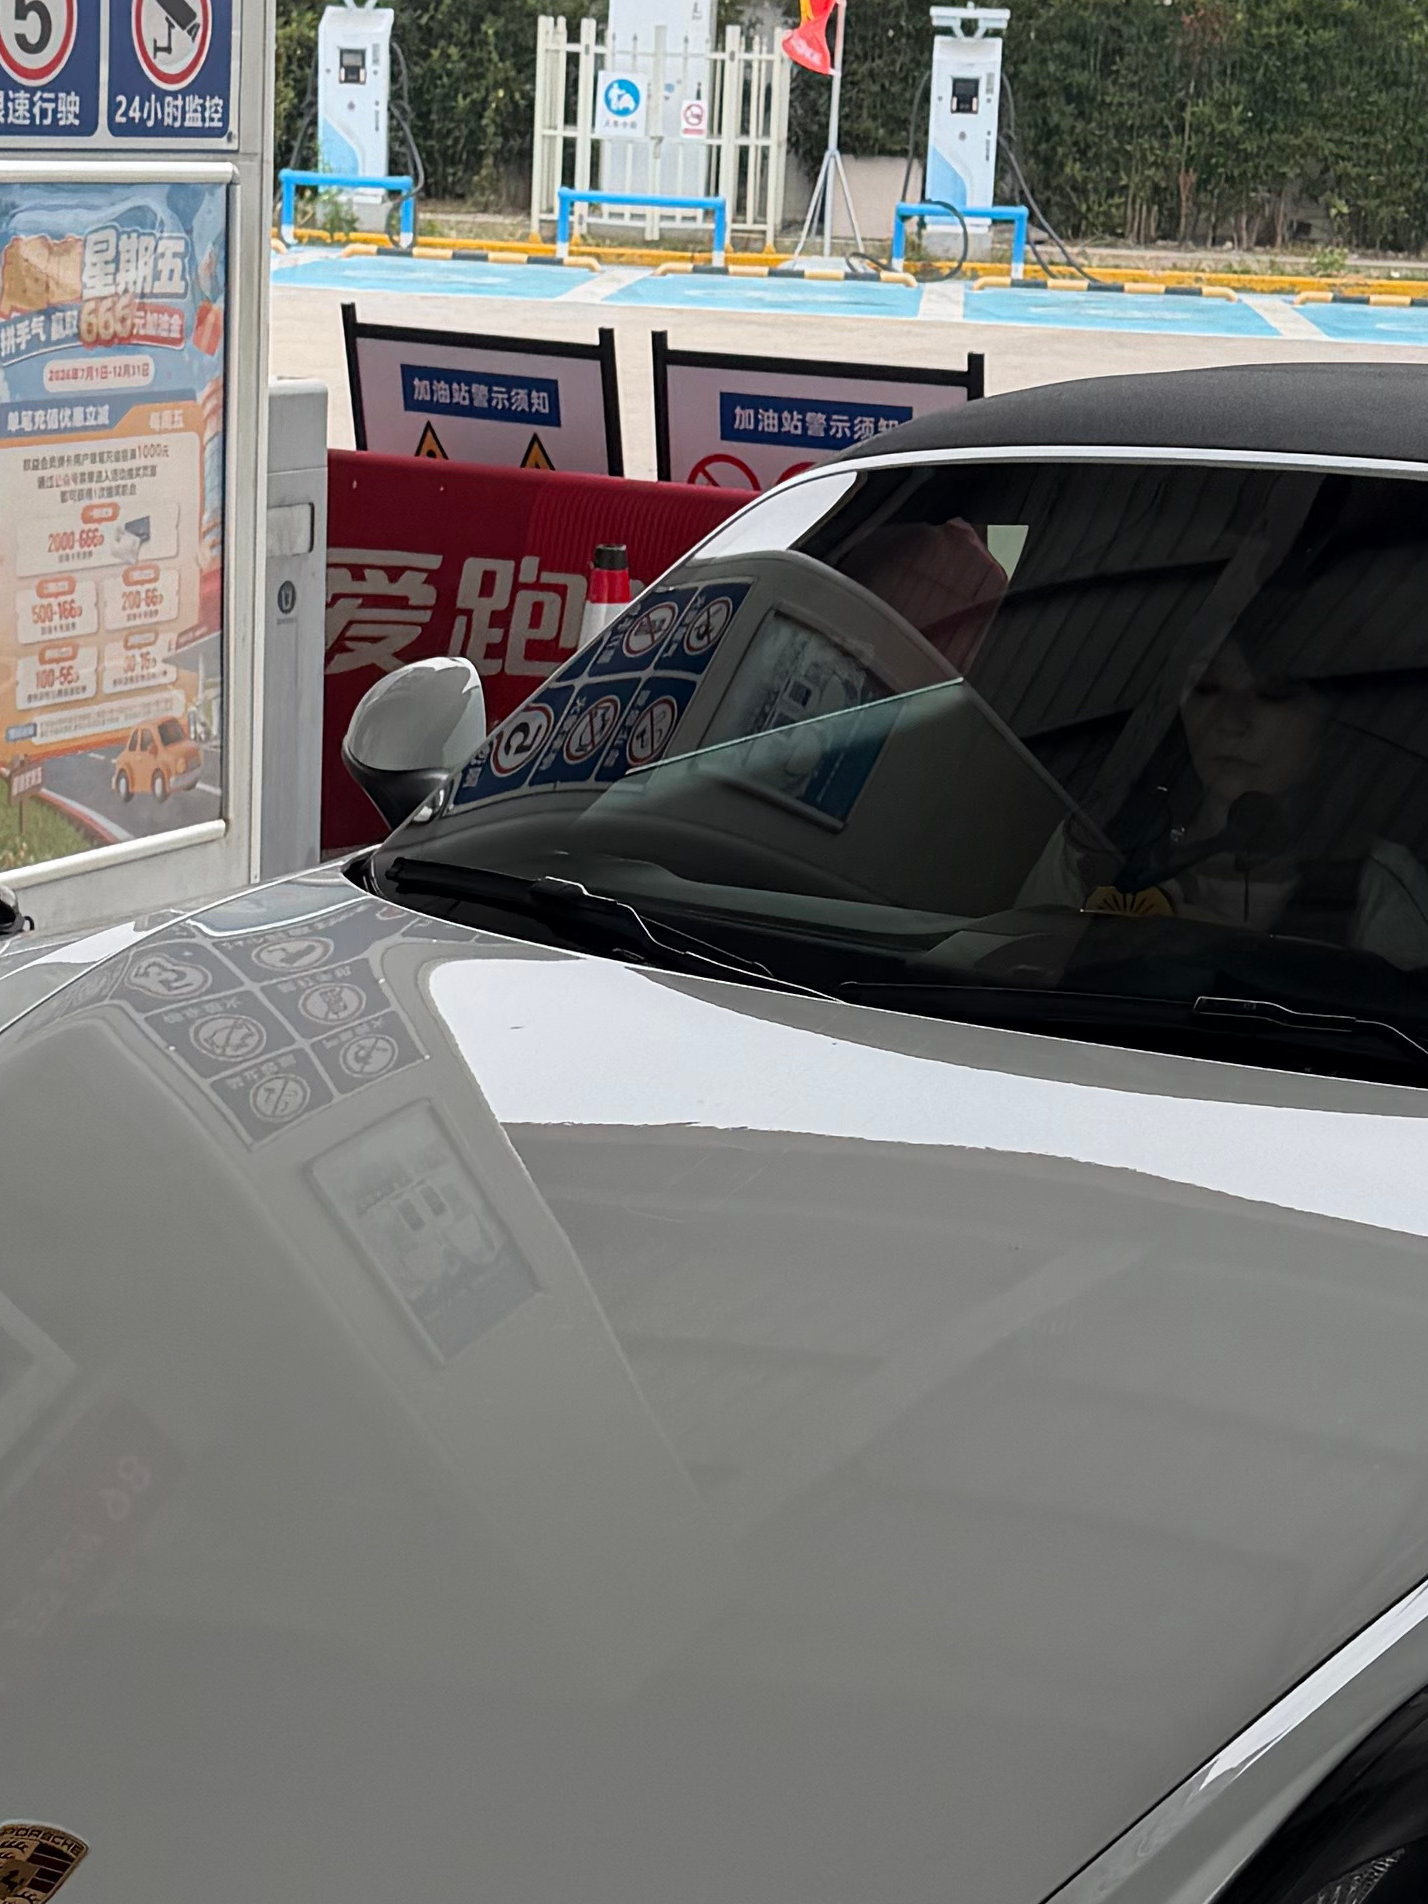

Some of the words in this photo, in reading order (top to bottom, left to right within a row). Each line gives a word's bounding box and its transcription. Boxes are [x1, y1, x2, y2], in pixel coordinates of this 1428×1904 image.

[115, 95, 224, 129] 24小时监控
[413, 376, 550, 415] 加油站警示须知
[325, 548, 588, 677] 爱跑
[0, 1826, 85, 1856] PORSCHE
